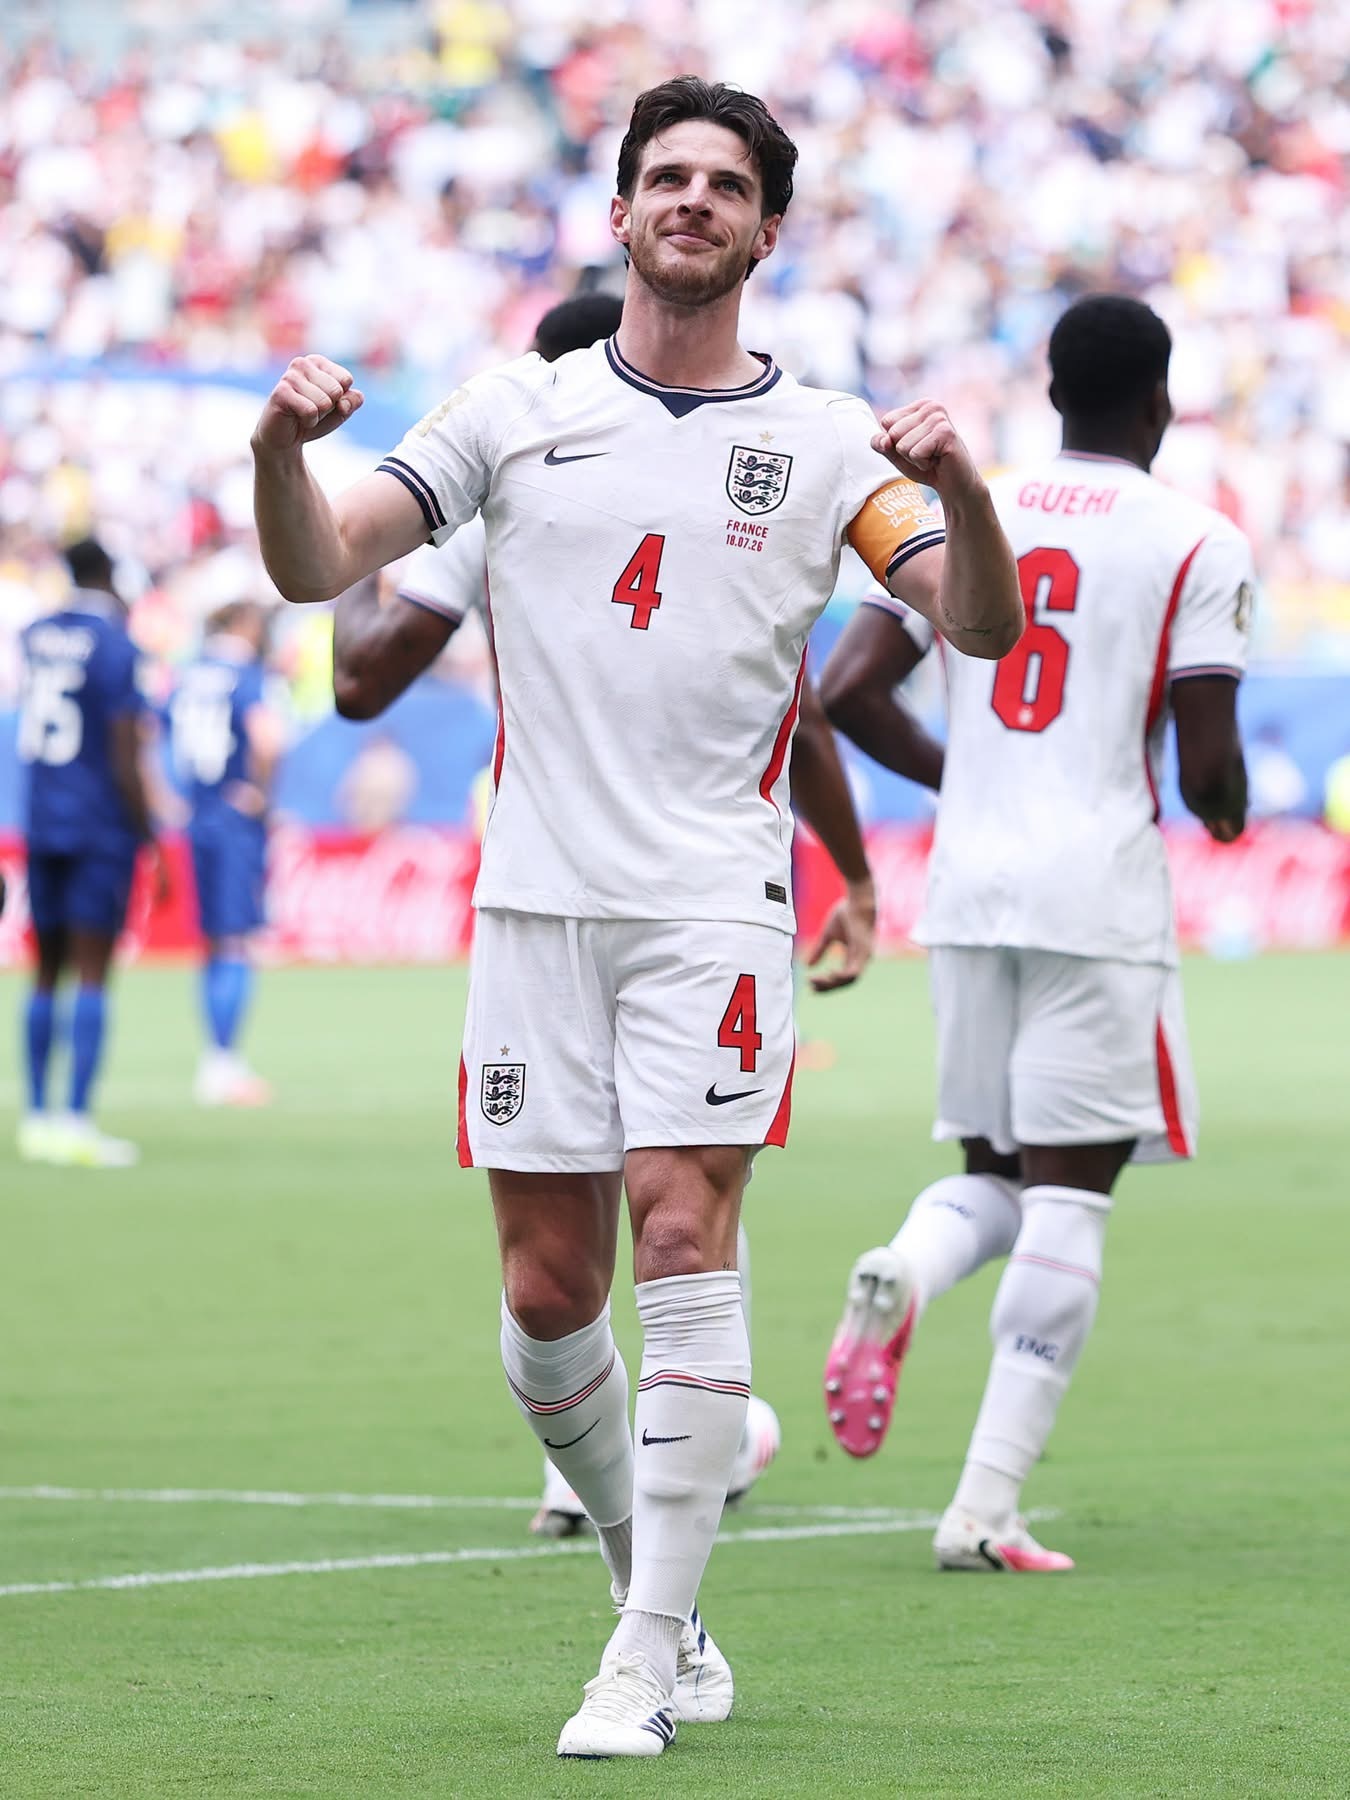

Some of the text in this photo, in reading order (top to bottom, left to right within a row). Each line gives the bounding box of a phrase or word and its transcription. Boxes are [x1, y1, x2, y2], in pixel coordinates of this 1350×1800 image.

[725, 534, 764, 552] 18.07.26
[726, 519, 769, 539] FRANCE
[611, 533, 666, 631] 4
[991, 547, 1080, 733] 6
[717, 973, 762, 1074] 4
